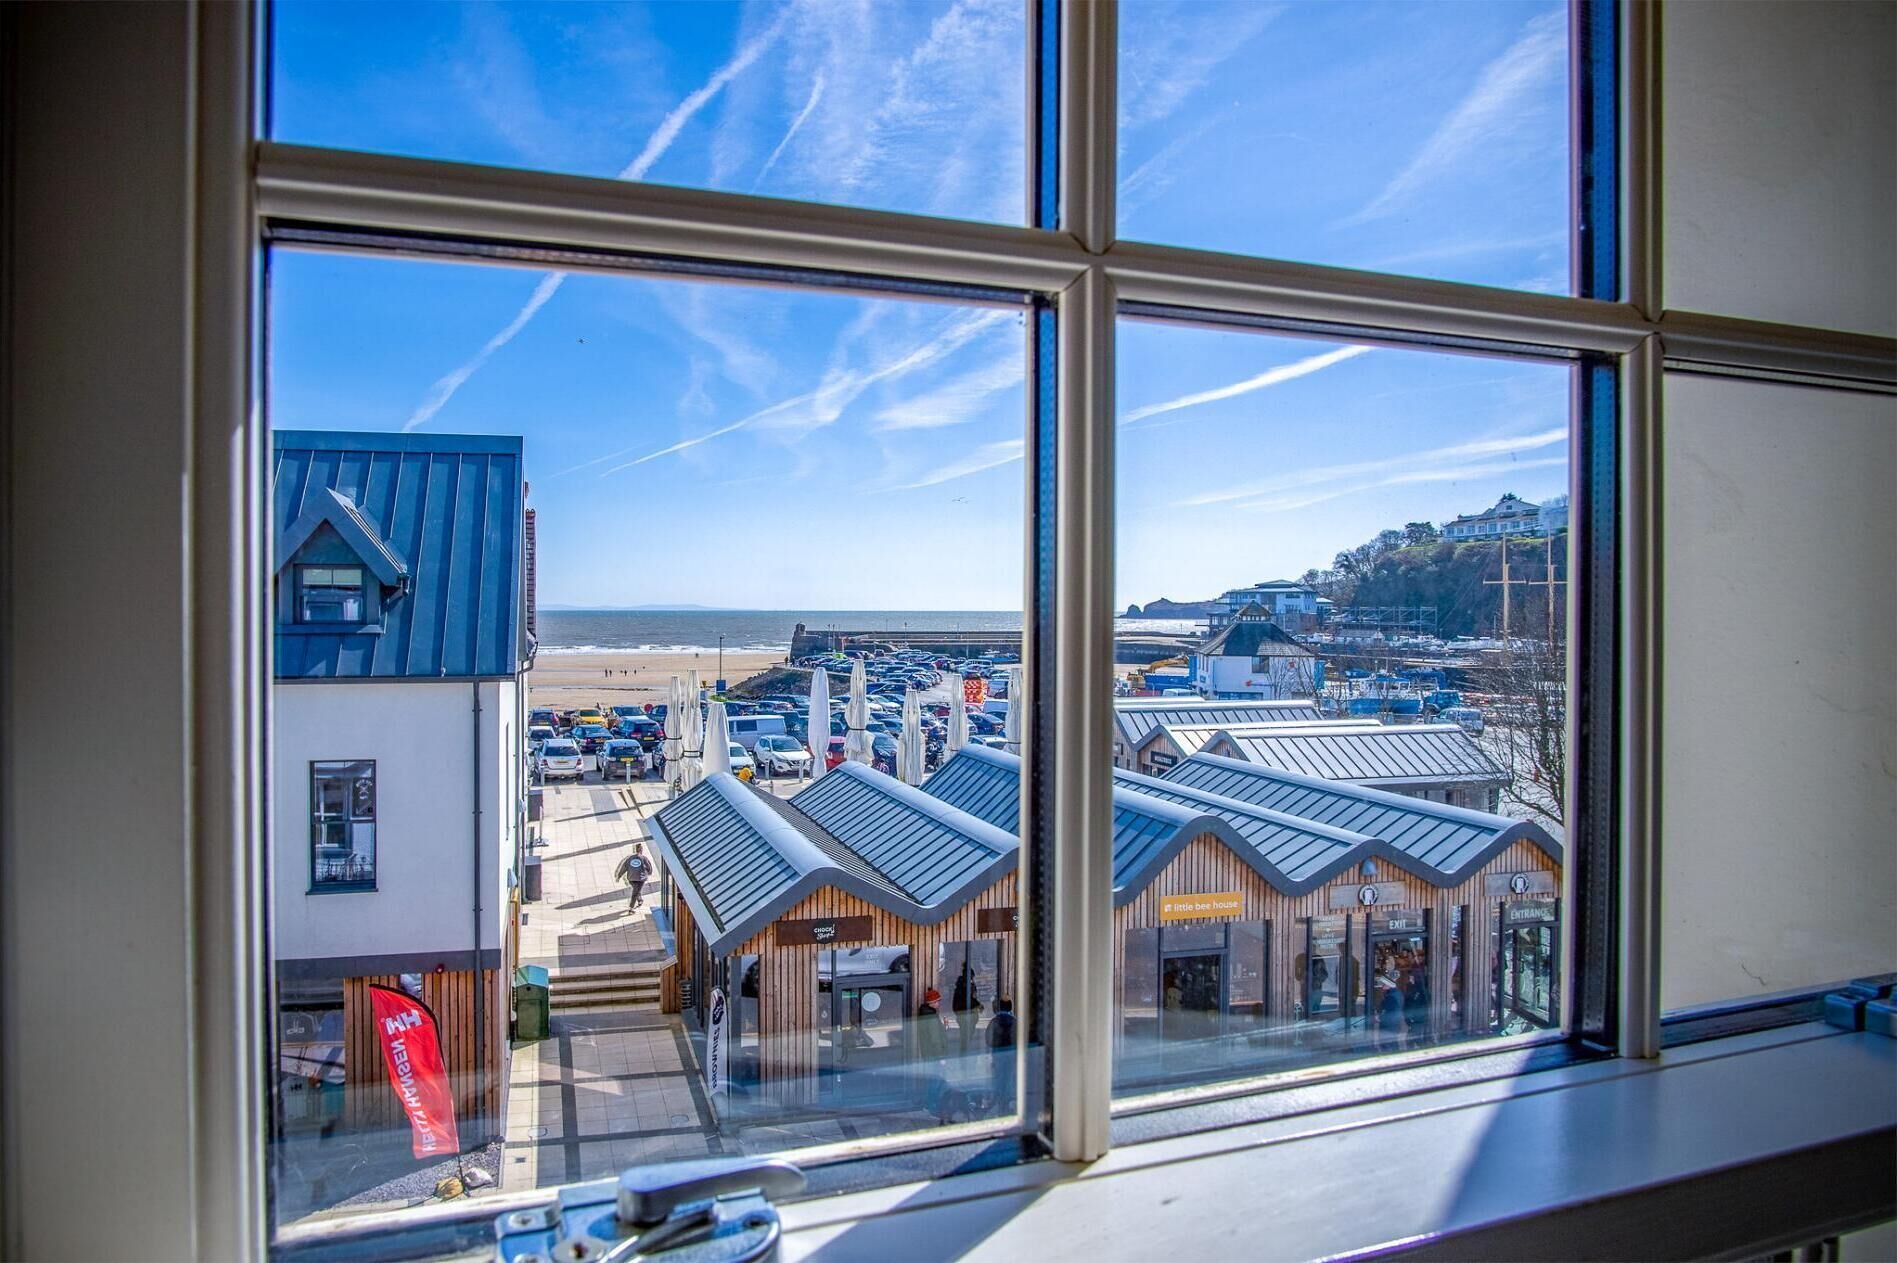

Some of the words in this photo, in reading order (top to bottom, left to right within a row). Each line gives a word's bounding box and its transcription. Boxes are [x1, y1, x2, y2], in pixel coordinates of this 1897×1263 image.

[1174, 902, 1193, 912] little
[1195, 902, 1211, 911] bee
[1213, 900, 1238, 909] house
[1389, 919, 1406, 929] EXIT
